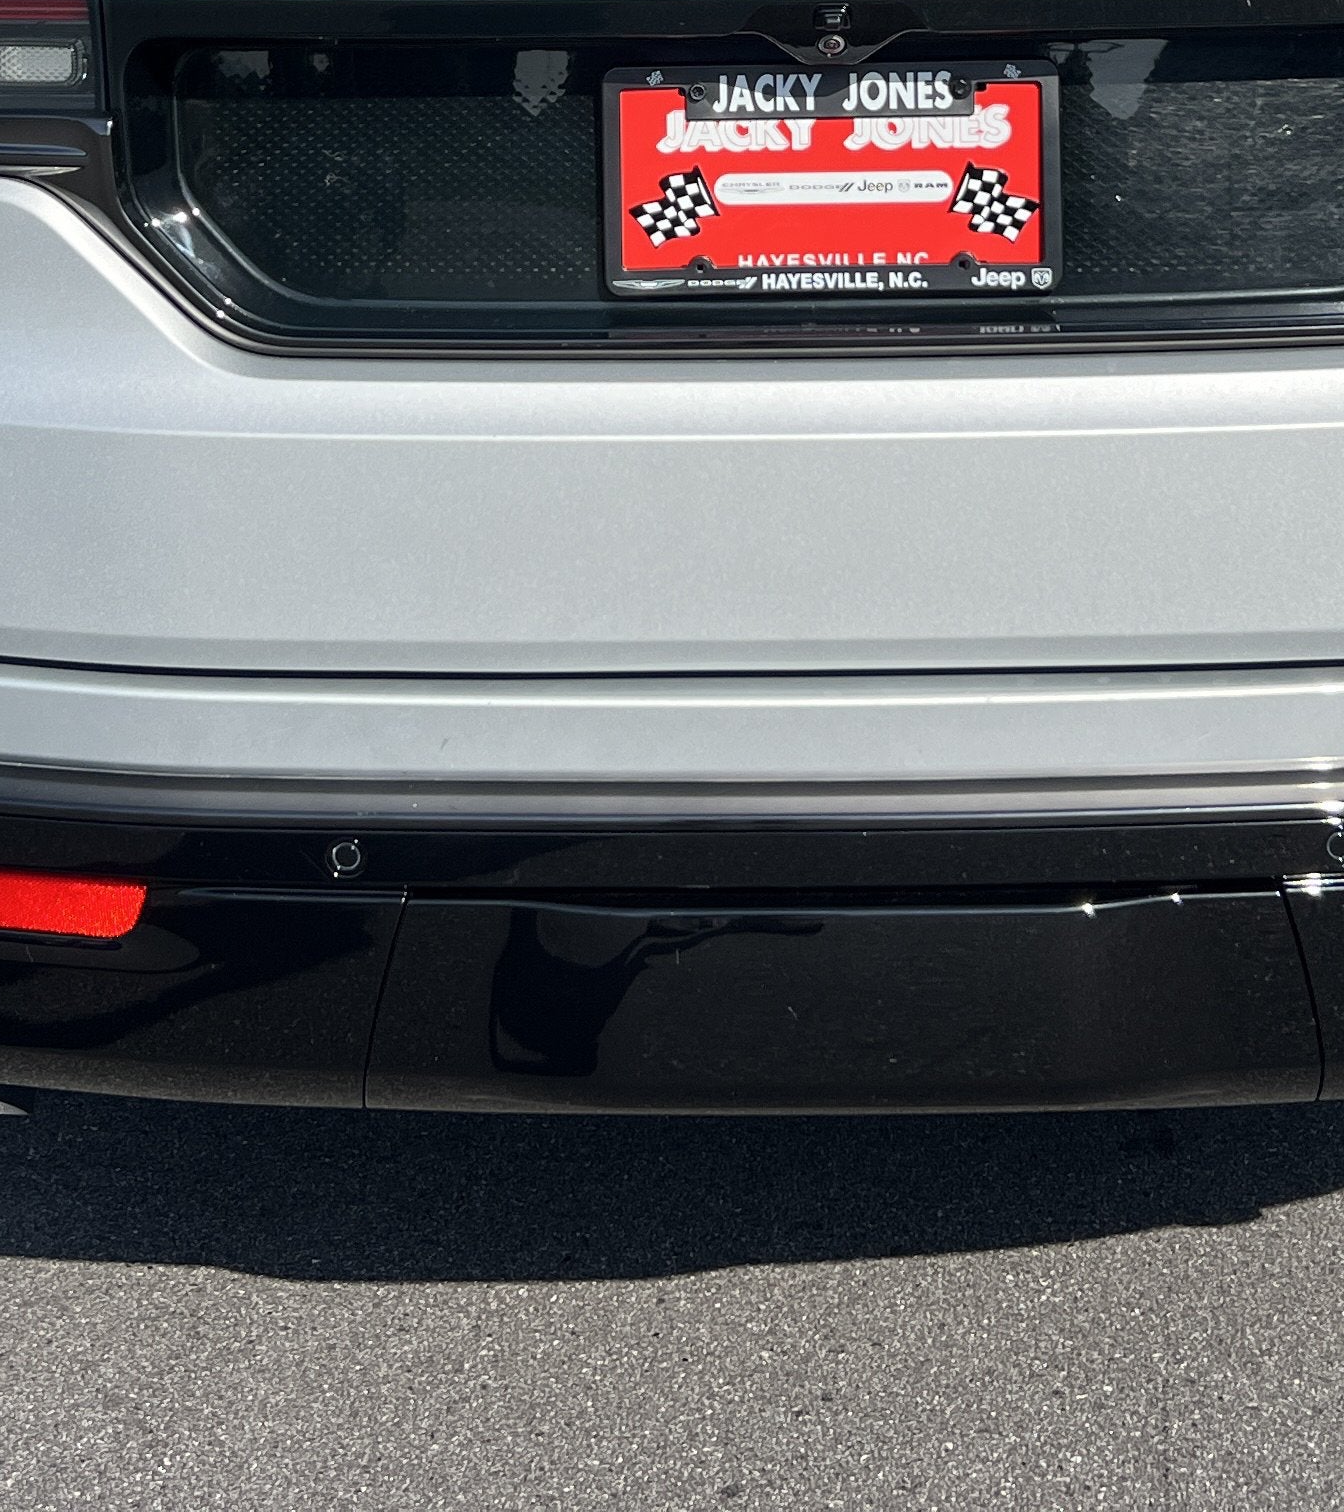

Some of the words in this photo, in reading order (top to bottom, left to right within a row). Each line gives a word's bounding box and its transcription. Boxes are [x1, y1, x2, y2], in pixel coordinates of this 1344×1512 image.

[712, 73, 822, 113] JACKY
[842, 70, 954, 111] JONES
[656, 109, 816, 153] JACKY
[843, 103, 1012, 151] JONES
[857, 179, 893, 194] Jeep
[762, 272, 884, 291] HAYESVILLE,
[888, 272, 928, 289] N.C.
[971, 268, 1025, 289] Jeep
